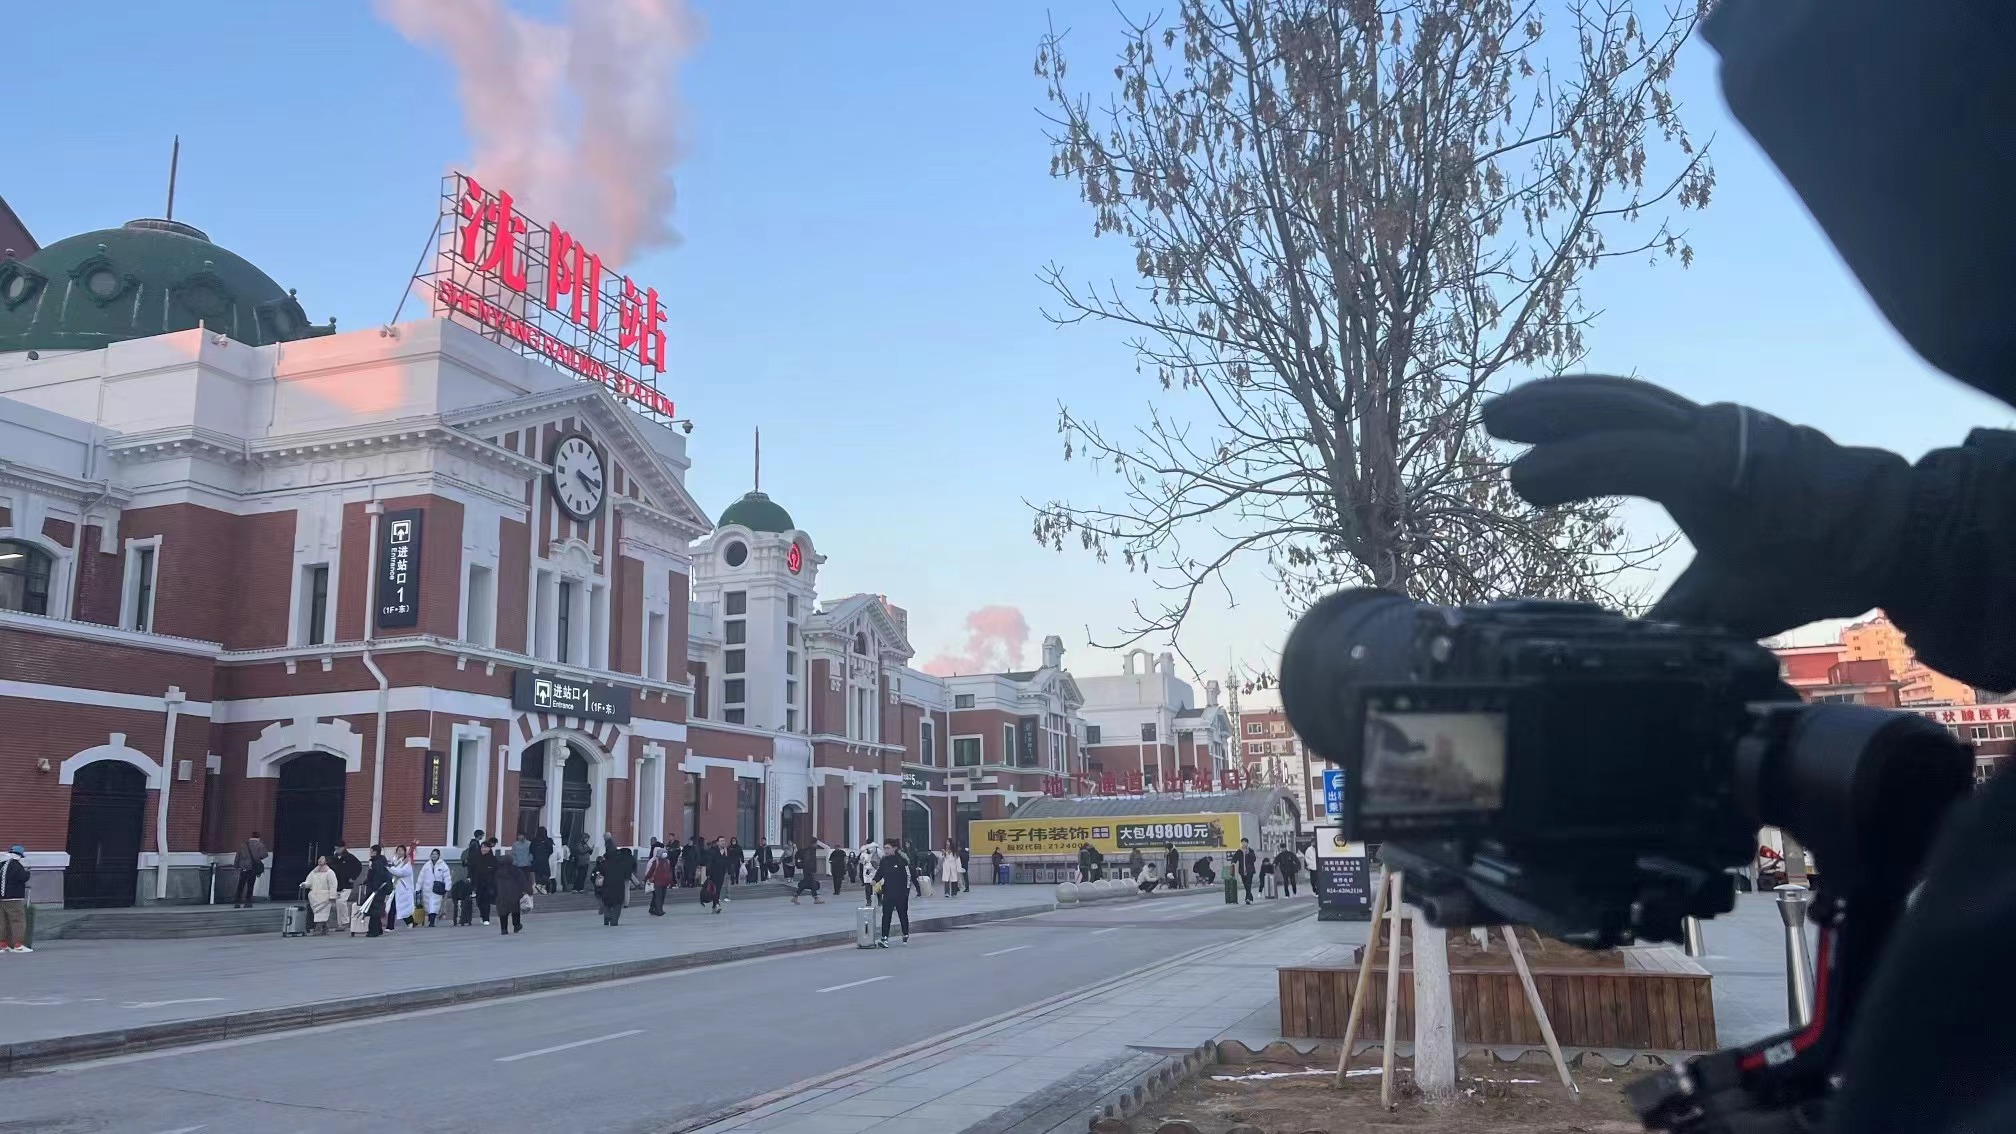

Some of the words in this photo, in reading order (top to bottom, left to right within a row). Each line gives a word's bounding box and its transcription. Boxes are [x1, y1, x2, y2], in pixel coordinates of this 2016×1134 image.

[460, 176, 667, 373] 沈阳站
[438, 280, 540, 350] SHENYANG
[543, 336, 610, 386] RAILWAY
[614, 373, 675, 419] STATION
[389, 547, 397, 580] Entrance
[397, 545, 408, 584] 进站口
[397, 586, 404, 602] 1
[552, 683, 580, 701] 进站口
[582, 689, 589, 712] 1
[552, 700, 574, 711] Entrance
[987, 826, 1089, 842] 峰子伟装饰
[1120, 824, 1208, 840] 大包49800元
